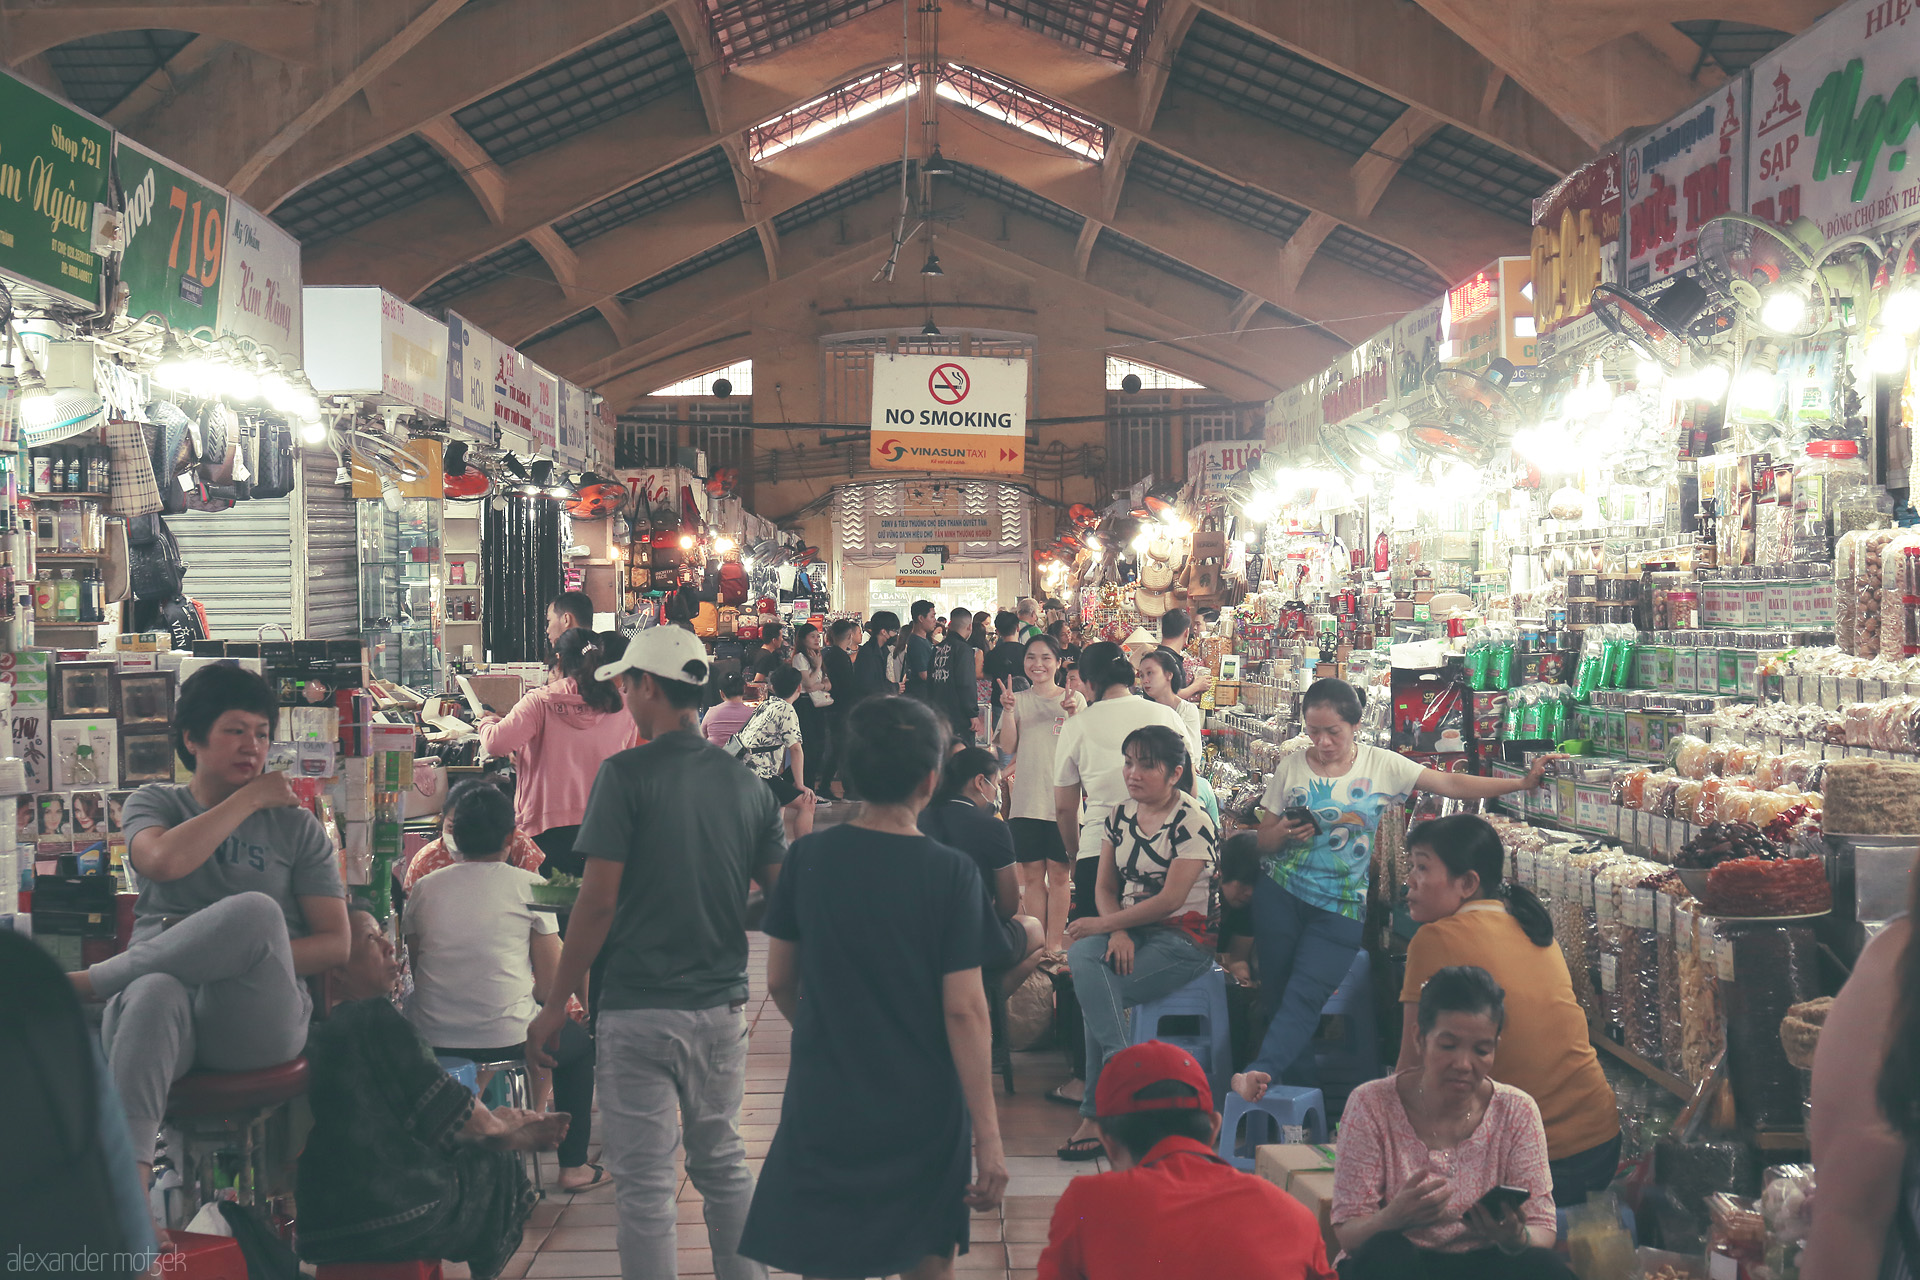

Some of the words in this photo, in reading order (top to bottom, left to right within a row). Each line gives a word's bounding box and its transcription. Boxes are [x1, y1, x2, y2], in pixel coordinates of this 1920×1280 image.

[51, 124, 78, 163] Shop
[81, 136, 101, 169] 721
[1759, 133, 1800, 182] SẠP
[28, 155, 87, 233] Ngân
[1826, 209, 1853, 240] ĐÔNG
[1853, 197, 1877, 228] CHỢ
[1877, 186, 1899, 219] BẾN
[168, 186, 222, 288] 719
[236, 260, 261, 317] Kim
[470, 376, 486, 413] HOA
[885, 408, 915, 425] NO
[919, 409, 1012, 429] SMOKING
[910, 447, 966, 458] VINASUN
[966, 449, 987, 459] TAXI
[871, 591, 907, 600] CABANA
[303, 742, 325, 750] OLAY
